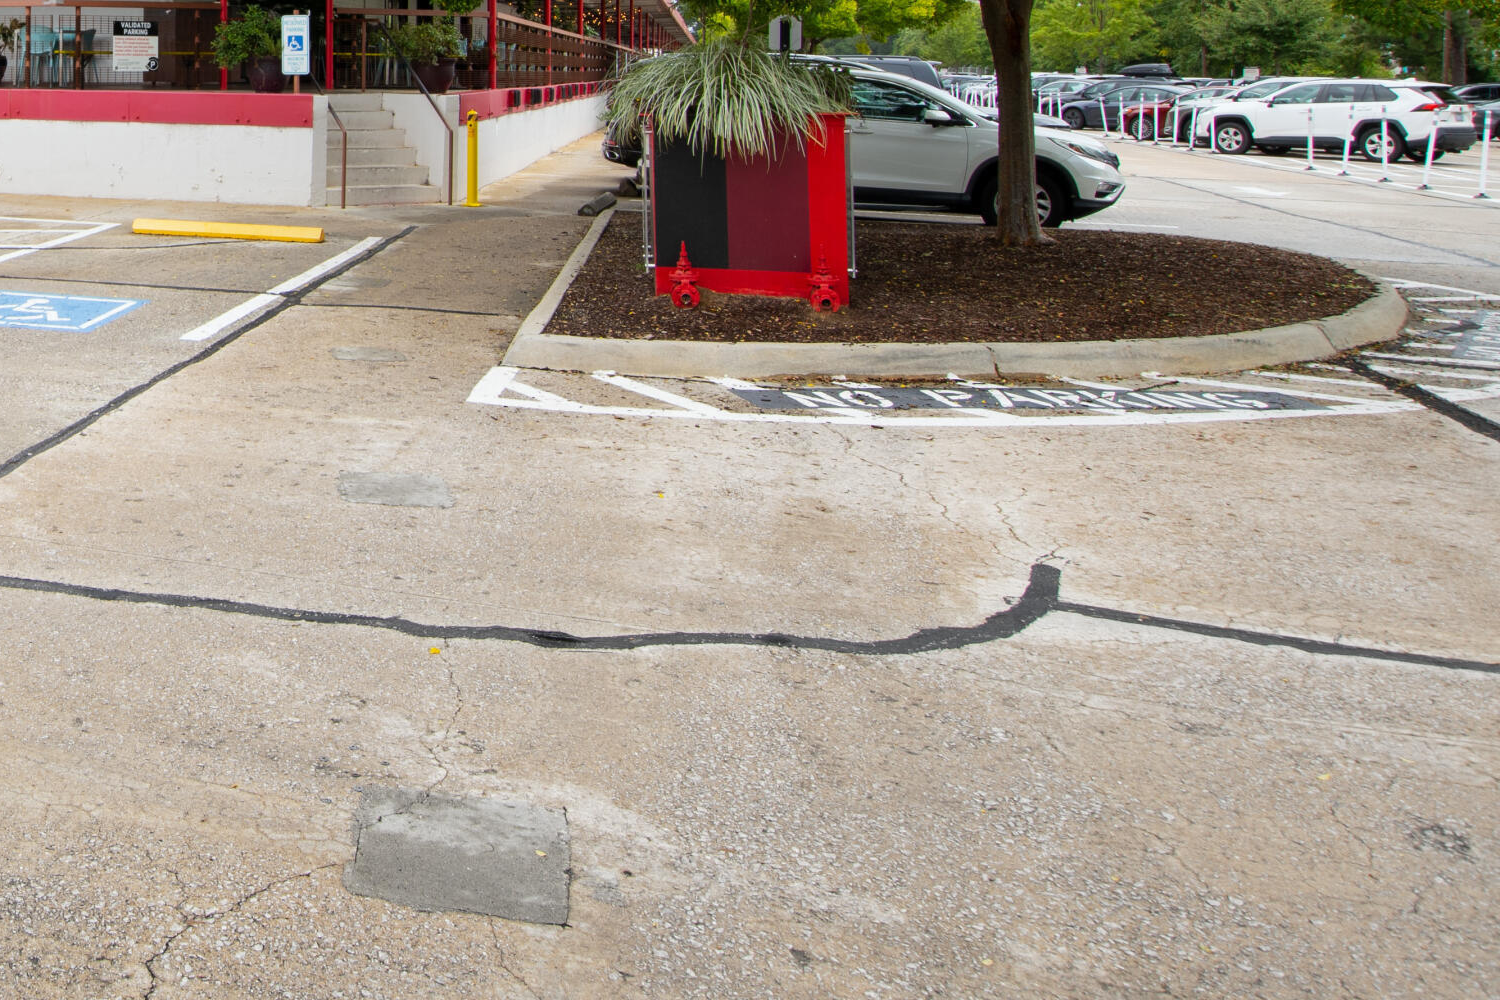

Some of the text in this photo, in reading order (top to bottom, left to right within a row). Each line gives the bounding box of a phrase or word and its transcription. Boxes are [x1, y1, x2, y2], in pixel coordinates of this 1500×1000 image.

[120, 21, 152, 29] VALIDATED
[123, 28, 149, 36] PARKING
[782, 387, 1271, 411] NO PARKING
